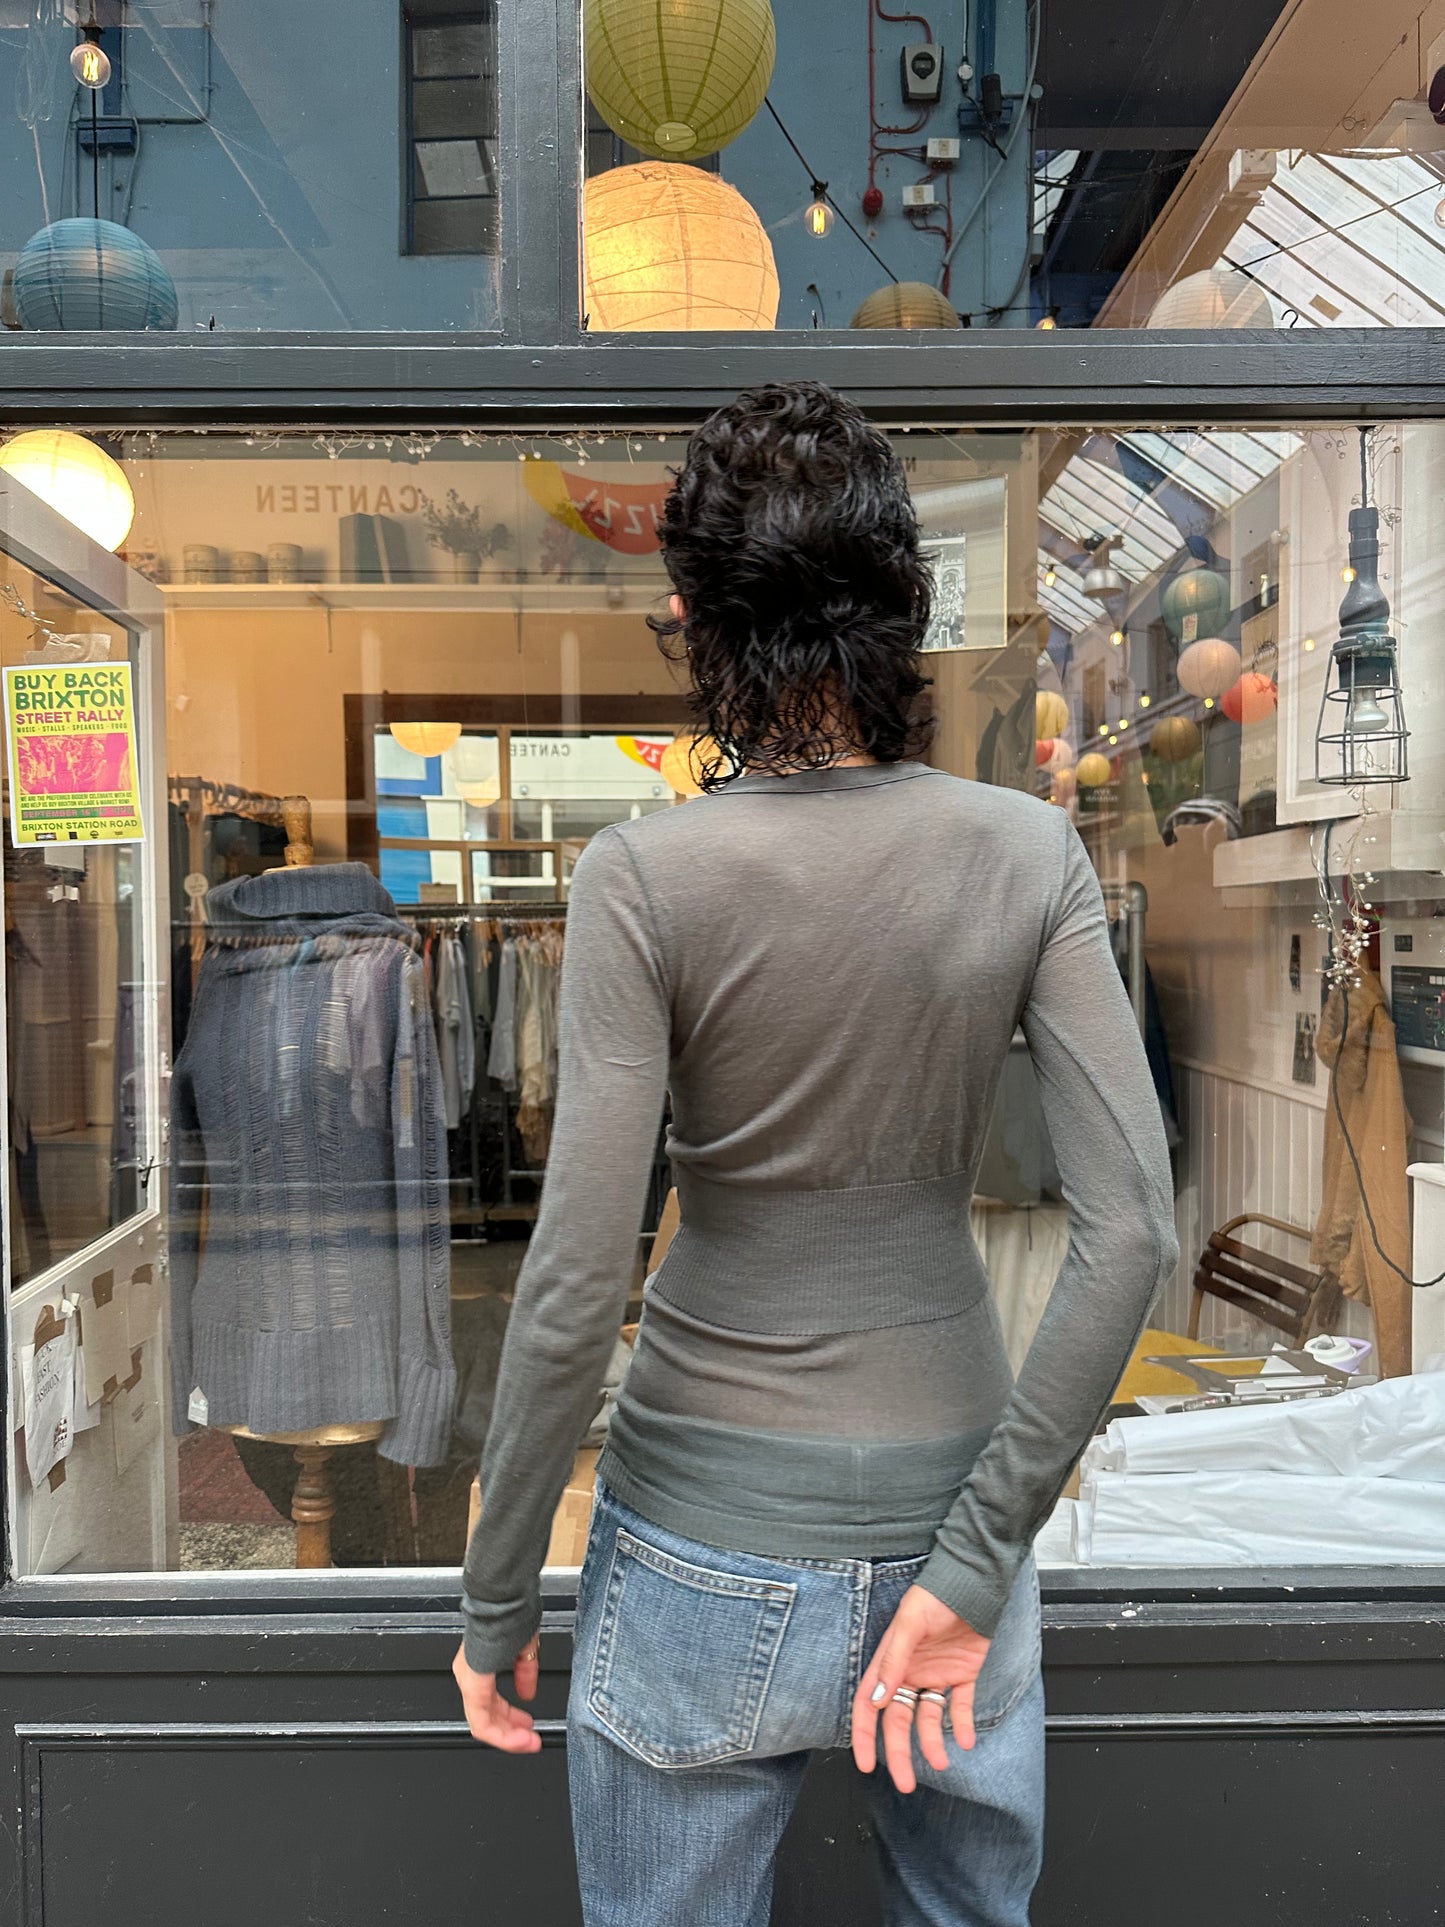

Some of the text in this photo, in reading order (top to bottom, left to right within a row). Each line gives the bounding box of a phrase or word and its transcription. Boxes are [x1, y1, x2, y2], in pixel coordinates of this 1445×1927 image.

[14, 672, 123, 690] BUY BACK
[15, 689, 125, 710] BRIXTON
[16, 709, 124, 725] STREET RALLY
[22, 819, 138, 831] BRIXTON STATION ROAD
